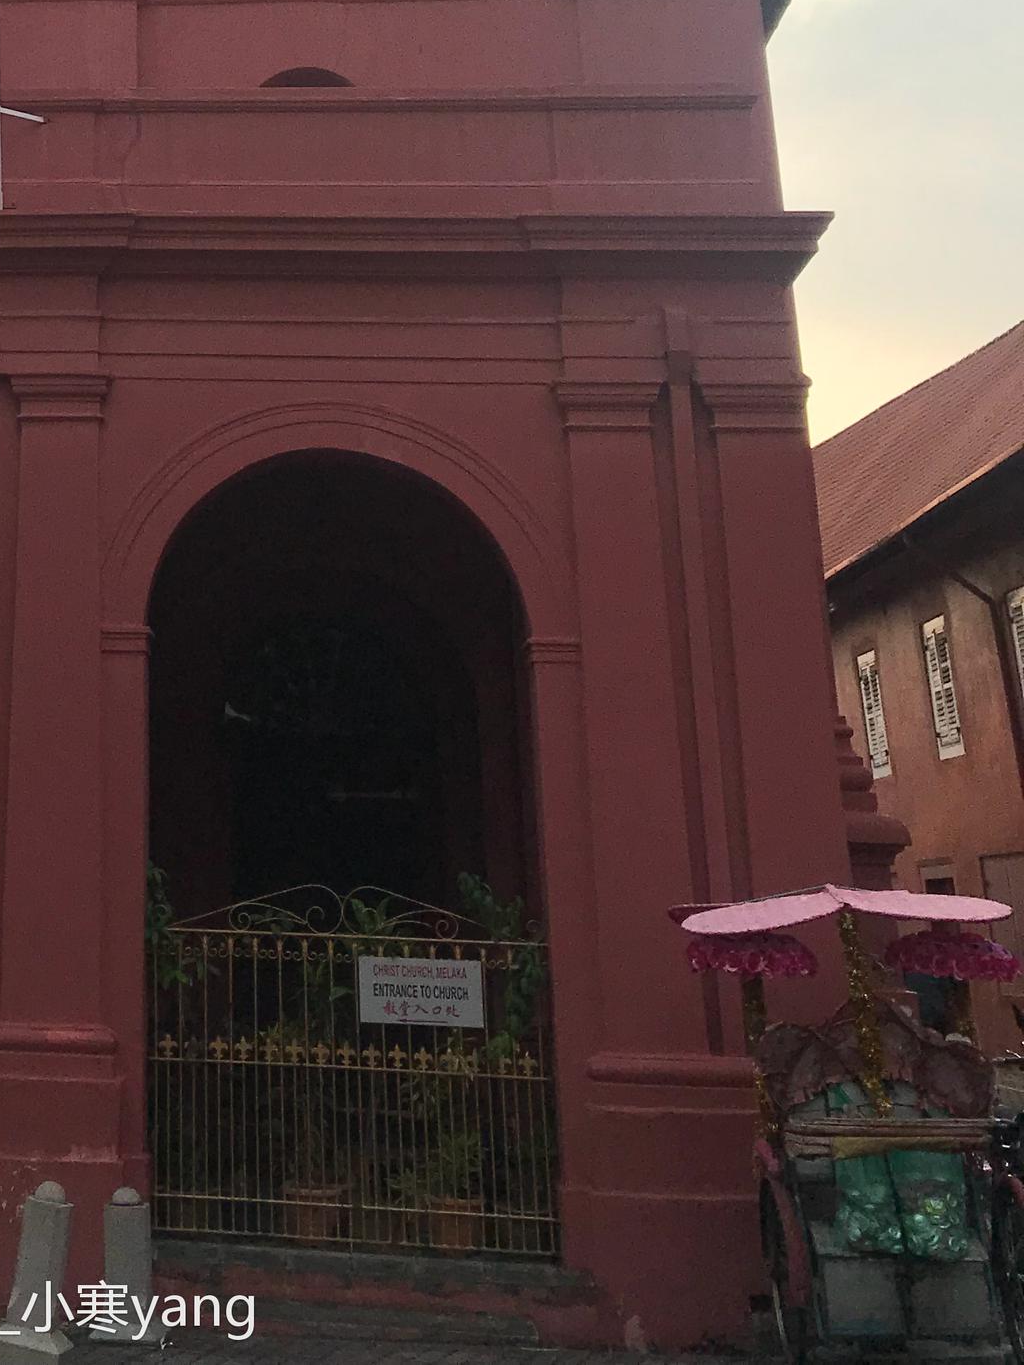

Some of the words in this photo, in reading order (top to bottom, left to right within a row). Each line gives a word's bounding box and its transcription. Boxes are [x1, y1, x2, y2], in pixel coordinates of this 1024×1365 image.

[373, 964, 400, 977] CHRIST
[436, 967, 468, 979] MELAKA
[373, 983, 418, 998] ENTRANCE
[419, 985, 431, 999] TO
[433, 985, 469, 1000] CHURCH
